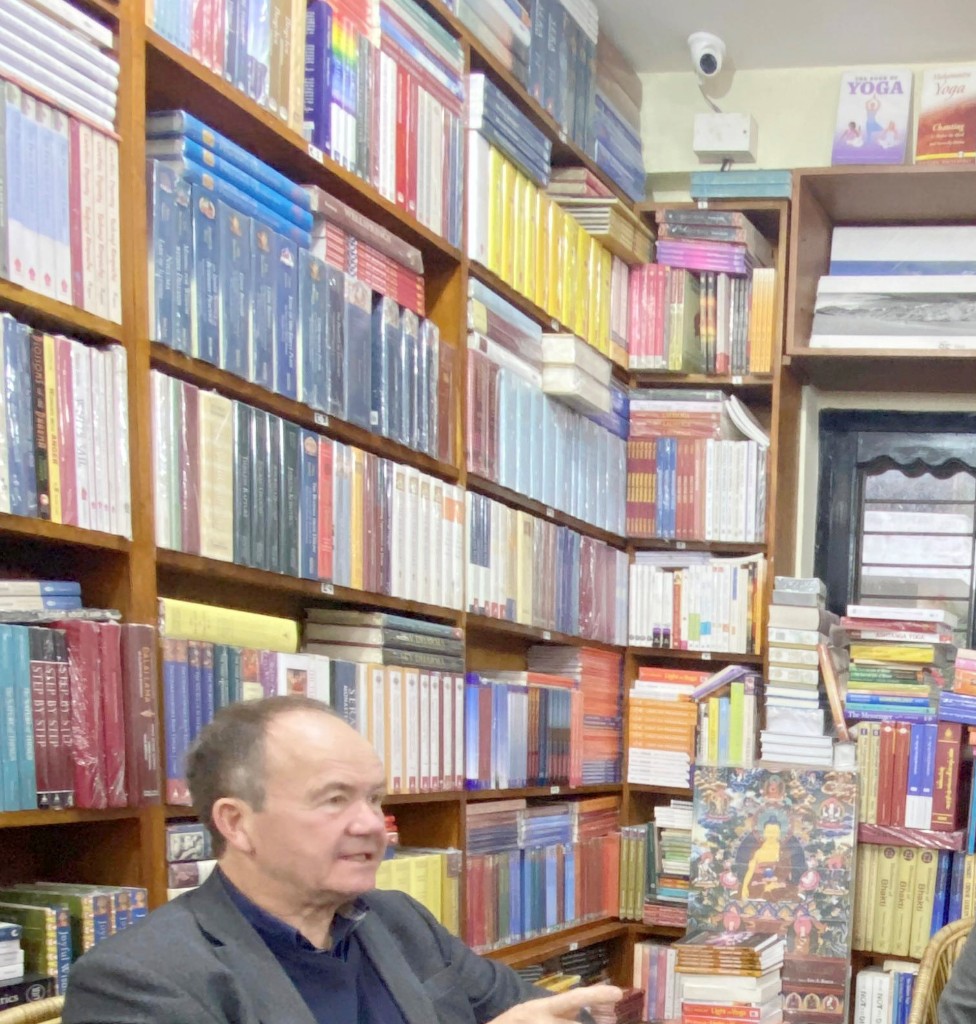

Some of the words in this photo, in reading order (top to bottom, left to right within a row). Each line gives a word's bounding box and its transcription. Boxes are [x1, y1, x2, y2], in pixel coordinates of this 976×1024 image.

[847, 81, 904, 95] YOGA
[935, 82, 966, 99] Yoga
[32, 666, 44, 695] STEP
[45, 665, 57, 697] STEP
[34, 700, 45, 713] BY
[47, 700, 57, 713] BY
[848, 710, 860, 718] The
[861, 711, 893, 721] Messenger
[35, 720, 47, 747] STEP
[48, 720, 59, 747] STEP
[880, 879, 888, 907] Bhakti
[897, 881, 907, 909] Bhakti
[916, 884, 926, 912] Bhakti
[58, 931, 70, 961] Joyful
[711, 1007, 726, 1015] Light
[732, 1009, 746, 1017] Yoga
